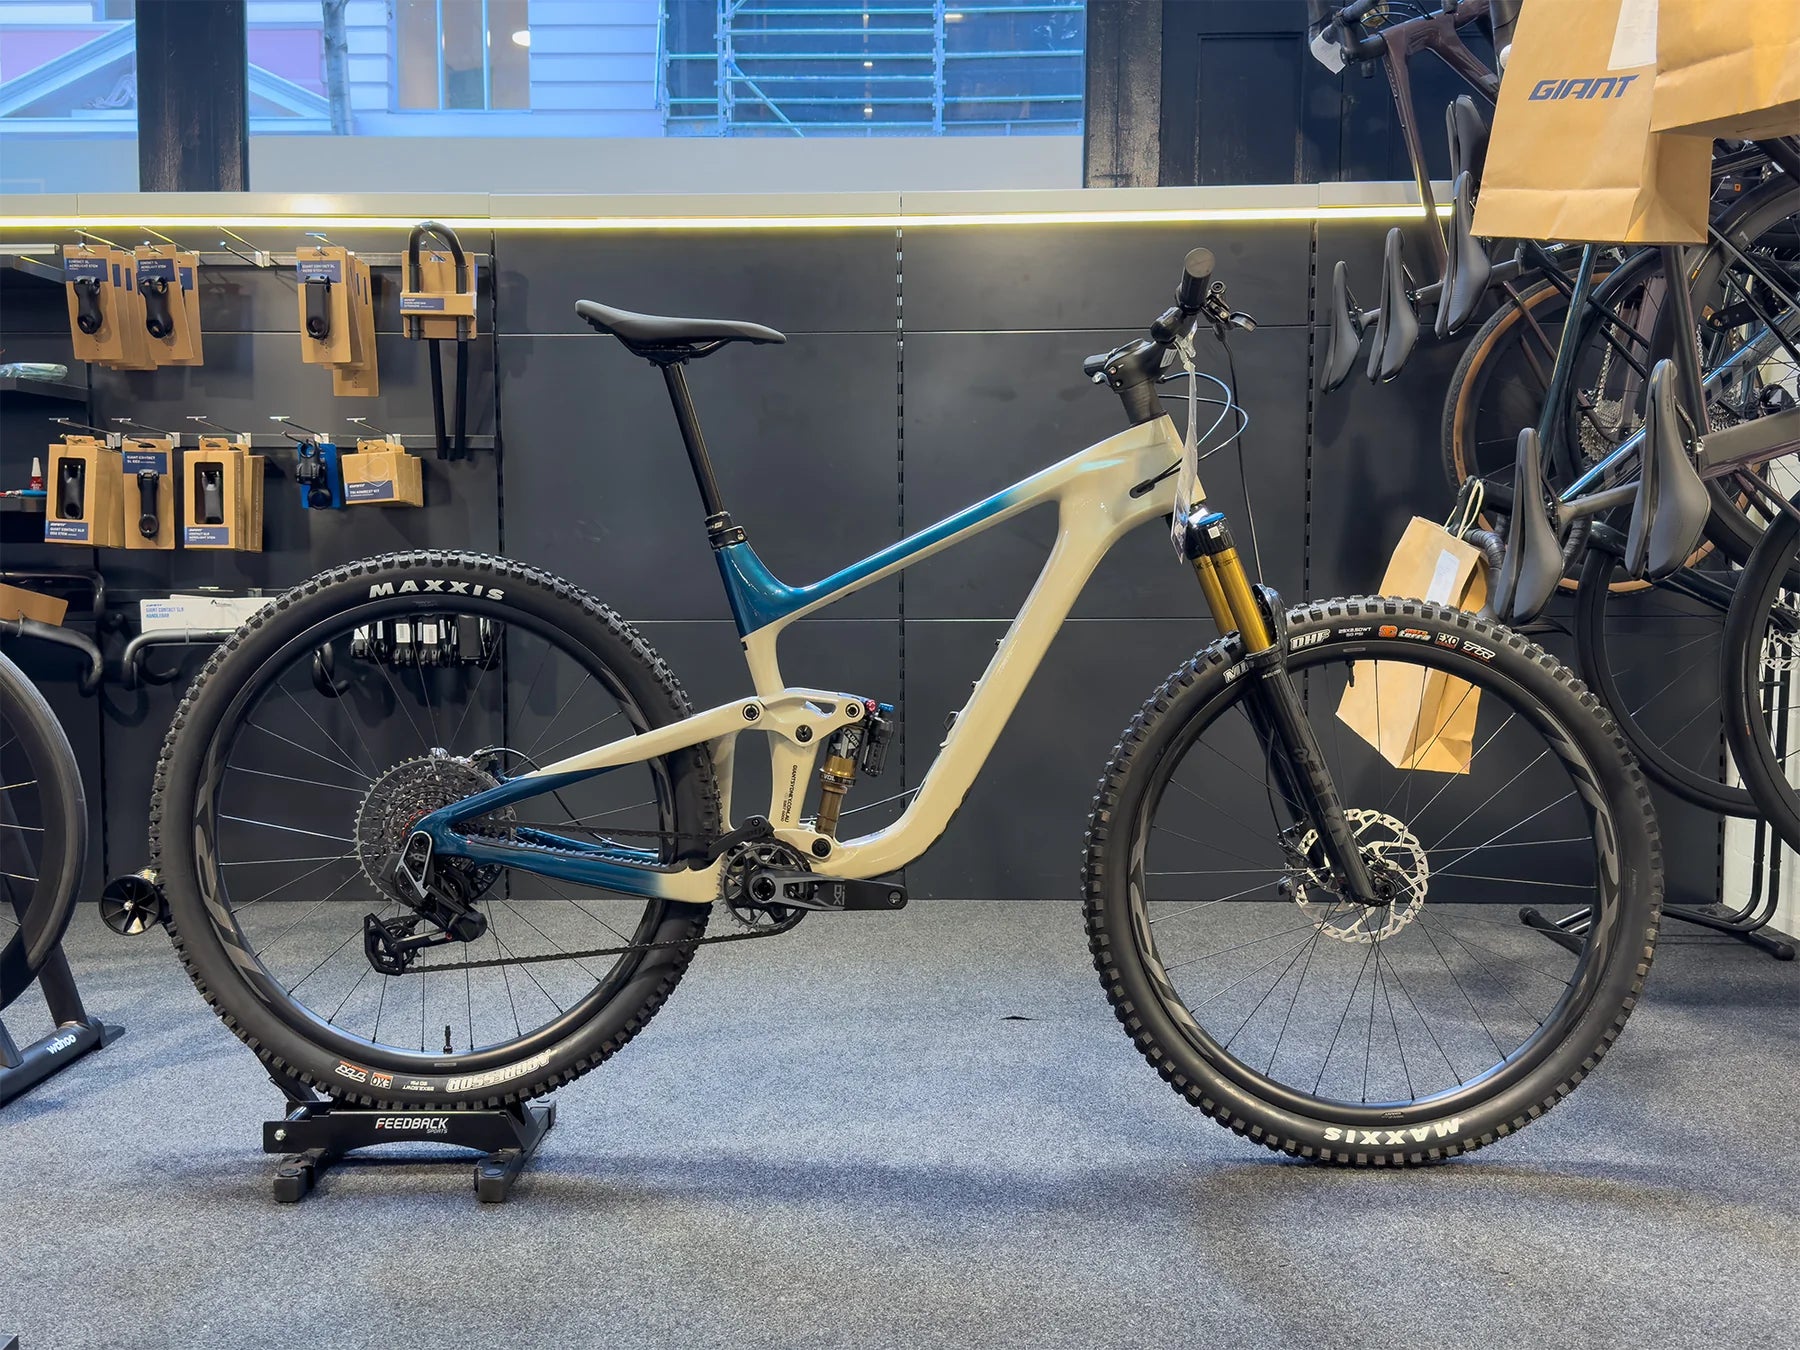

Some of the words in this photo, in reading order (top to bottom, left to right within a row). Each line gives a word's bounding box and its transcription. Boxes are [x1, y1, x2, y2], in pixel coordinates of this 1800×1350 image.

[1528, 74, 1640, 101] GIANT
[368, 579, 505, 600] MAXXIS
[1437, 633, 1458, 645] EXO
[46, 1034, 77, 1055] wahoo
[446, 1049, 555, 1093] AGGRESSOR
[372, 1075, 392, 1089] EXO
[375, 1117, 449, 1130] FEEDBACK
[1323, 1117, 1460, 1145] MAXXIS
